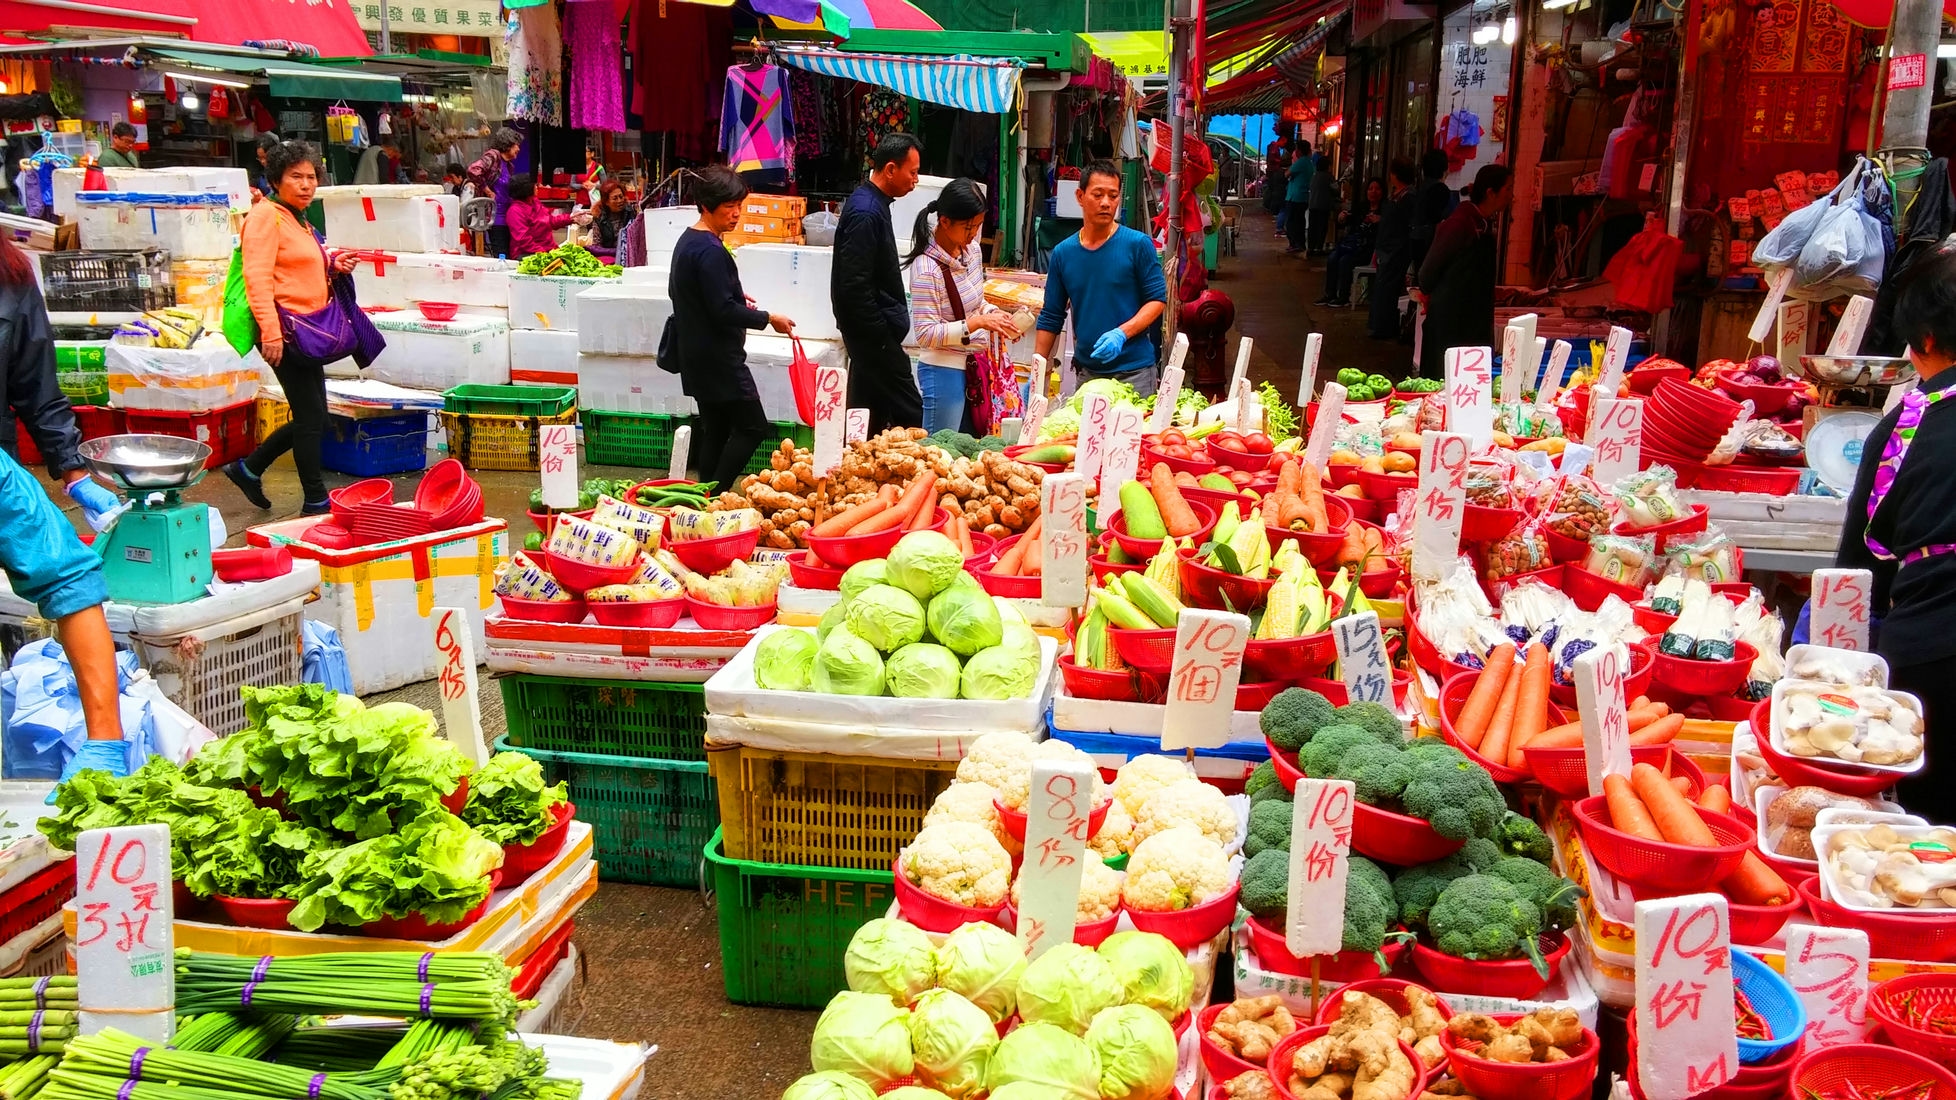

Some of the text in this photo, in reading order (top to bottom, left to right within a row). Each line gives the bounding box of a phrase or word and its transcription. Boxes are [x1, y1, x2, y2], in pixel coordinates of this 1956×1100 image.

[1456, 46, 1488, 66] 肥肥
[1454, 68, 1486, 88] 海鮮
[1454, 348, 1490, 385] 12元
[1452, 384, 1481, 408] 份
[1600, 401, 1641, 447] 10元
[542, 427, 576, 455] 10元
[1597, 438, 1623, 463] 份
[541, 453, 563, 474] 份
[1430, 436, 1468, 491] 10元
[616, 505, 655, 525] 山野
[1424, 487, 1454, 520] 份
[573, 524, 614, 548] 山野
[676, 513, 701, 529] 山野
[522, 568, 561, 600] 山野
[643, 565, 678, 591] 山野
[1184, 617, 1243, 669] 10元
[439, 664, 466, 701] 份
[1045, 774, 1087, 842] 8元
[1308, 783, 1353, 848] 10元
[86, 832, 163, 913] 10元
[1304, 840, 1338, 882] 份
[1652, 905, 1731, 976] 10元
[1649, 979, 1707, 1030] 份
